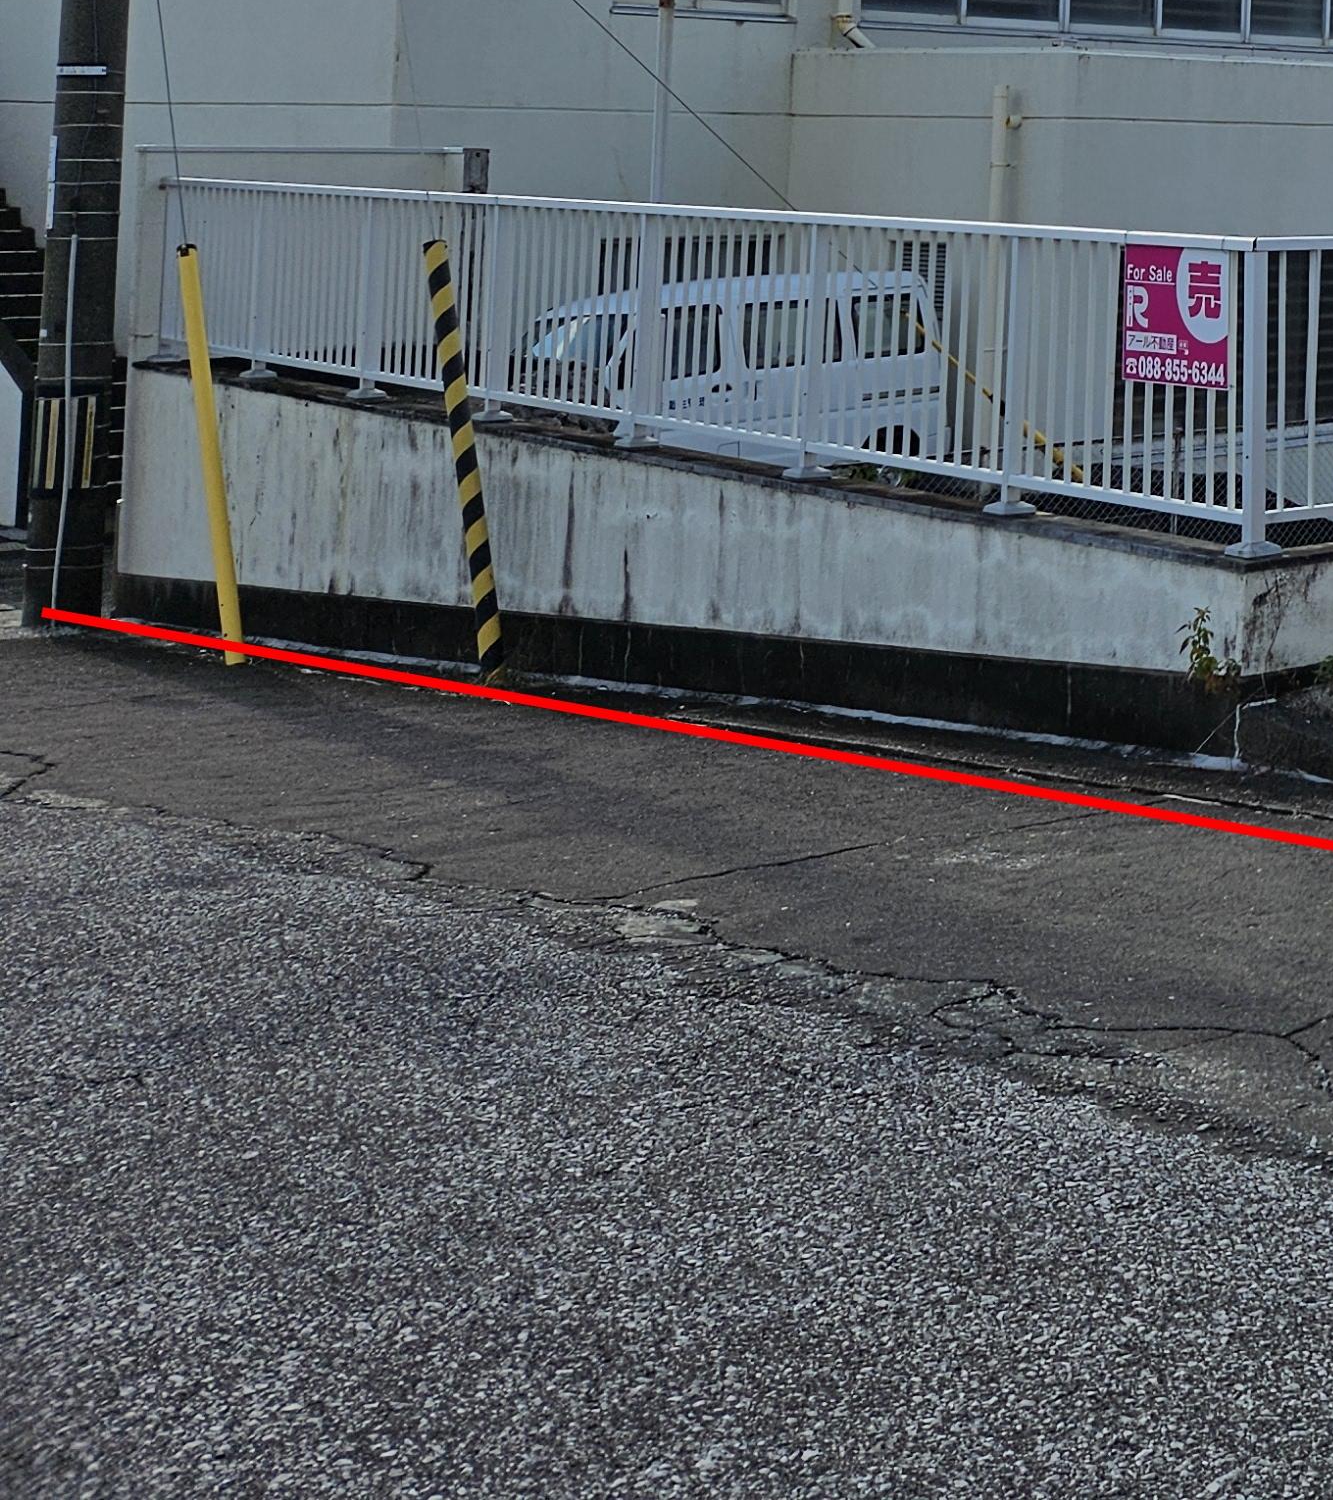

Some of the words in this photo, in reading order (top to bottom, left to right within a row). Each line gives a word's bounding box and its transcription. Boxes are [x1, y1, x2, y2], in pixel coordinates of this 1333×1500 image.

[1127, 264, 1145, 280] For
[1149, 265, 1172, 282] Sale
[1188, 261, 1222, 319] 売
